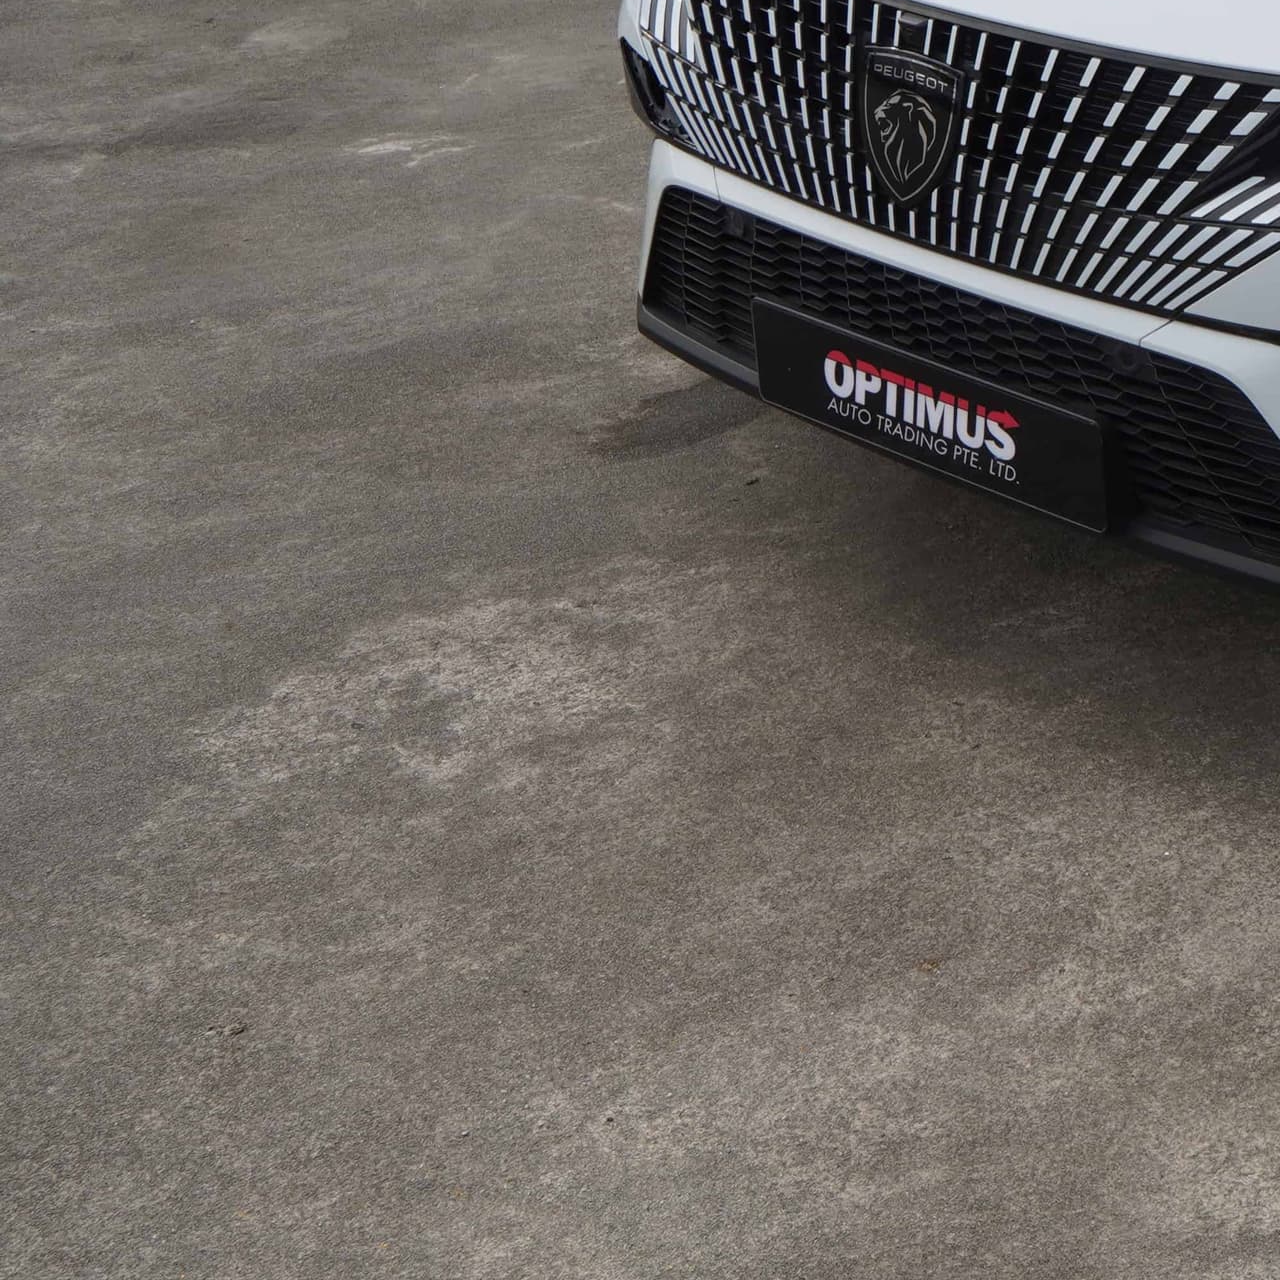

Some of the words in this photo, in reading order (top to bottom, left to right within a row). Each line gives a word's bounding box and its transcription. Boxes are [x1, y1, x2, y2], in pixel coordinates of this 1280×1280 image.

[873, 63, 949, 94] PEUGEOT
[824, 349, 1020, 461] OPTIMUS
[827, 397, 872, 425] AUTO
[876, 414, 948, 456] TRADING
[952, 445, 983, 470] PTE.
[988, 458, 1020, 485] LTD.
